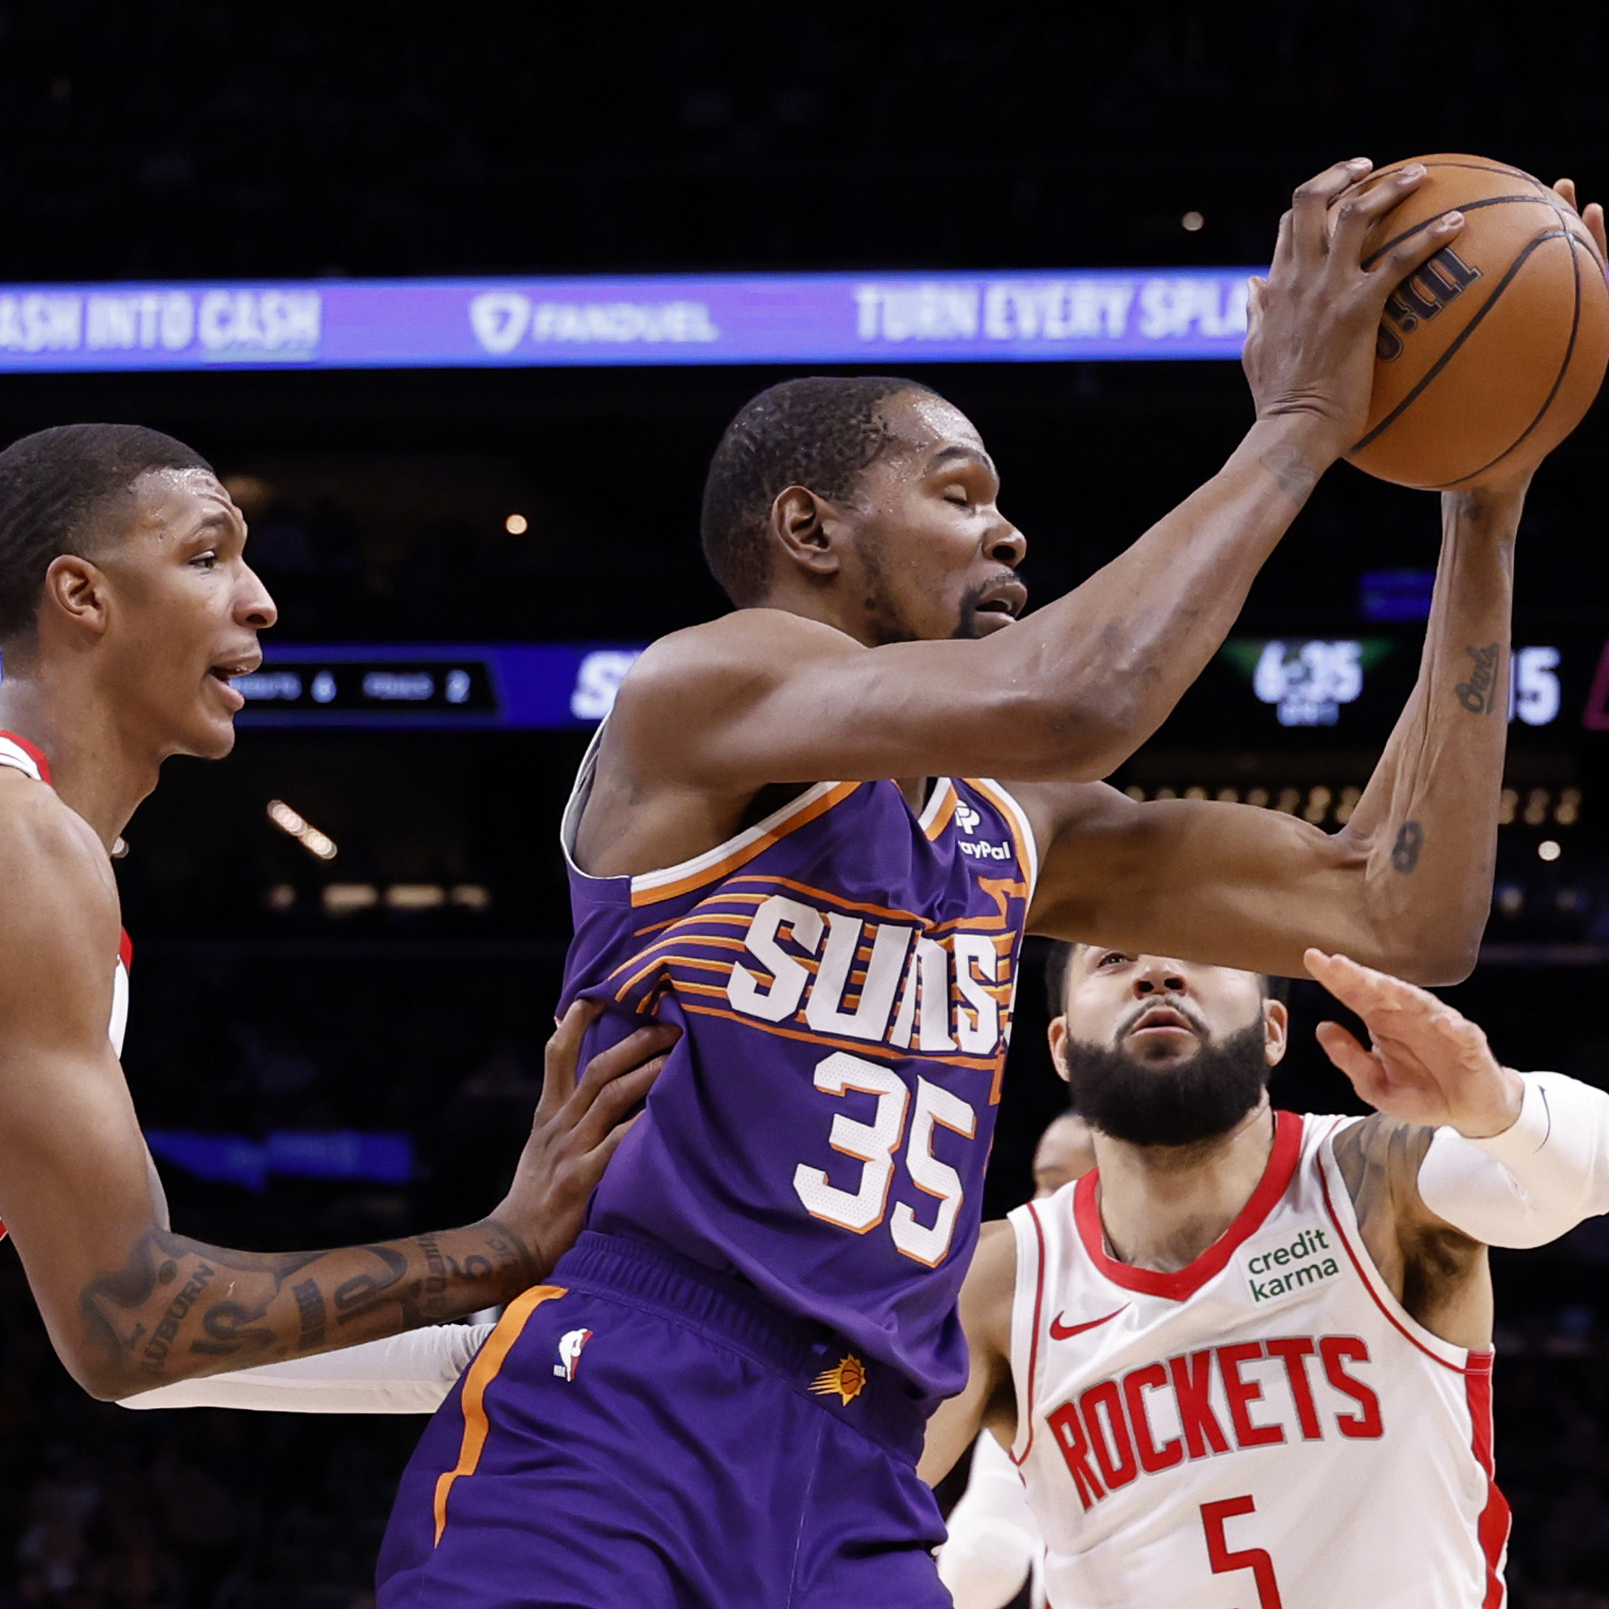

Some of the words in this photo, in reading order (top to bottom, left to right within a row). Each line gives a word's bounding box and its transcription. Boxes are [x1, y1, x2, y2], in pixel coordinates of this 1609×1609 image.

[86, 292, 194, 349] INTO
[198, 292, 321, 349] CASH
[532, 301, 719, 343] FANDUEL
[853, 281, 978, 341] TURN
[984, 280, 1134, 340] EVERY
[1509, 645, 1560, 726] 5
[958, 840, 1011, 860] ayPal
[726, 894, 998, 1055] SUNS
[793, 1051, 977, 1268] 35
[1248, 1227, 1330, 1275] credit
[1249, 1256, 1339, 1303] karma
[1045, 1335, 1385, 1513] ROCKETS
